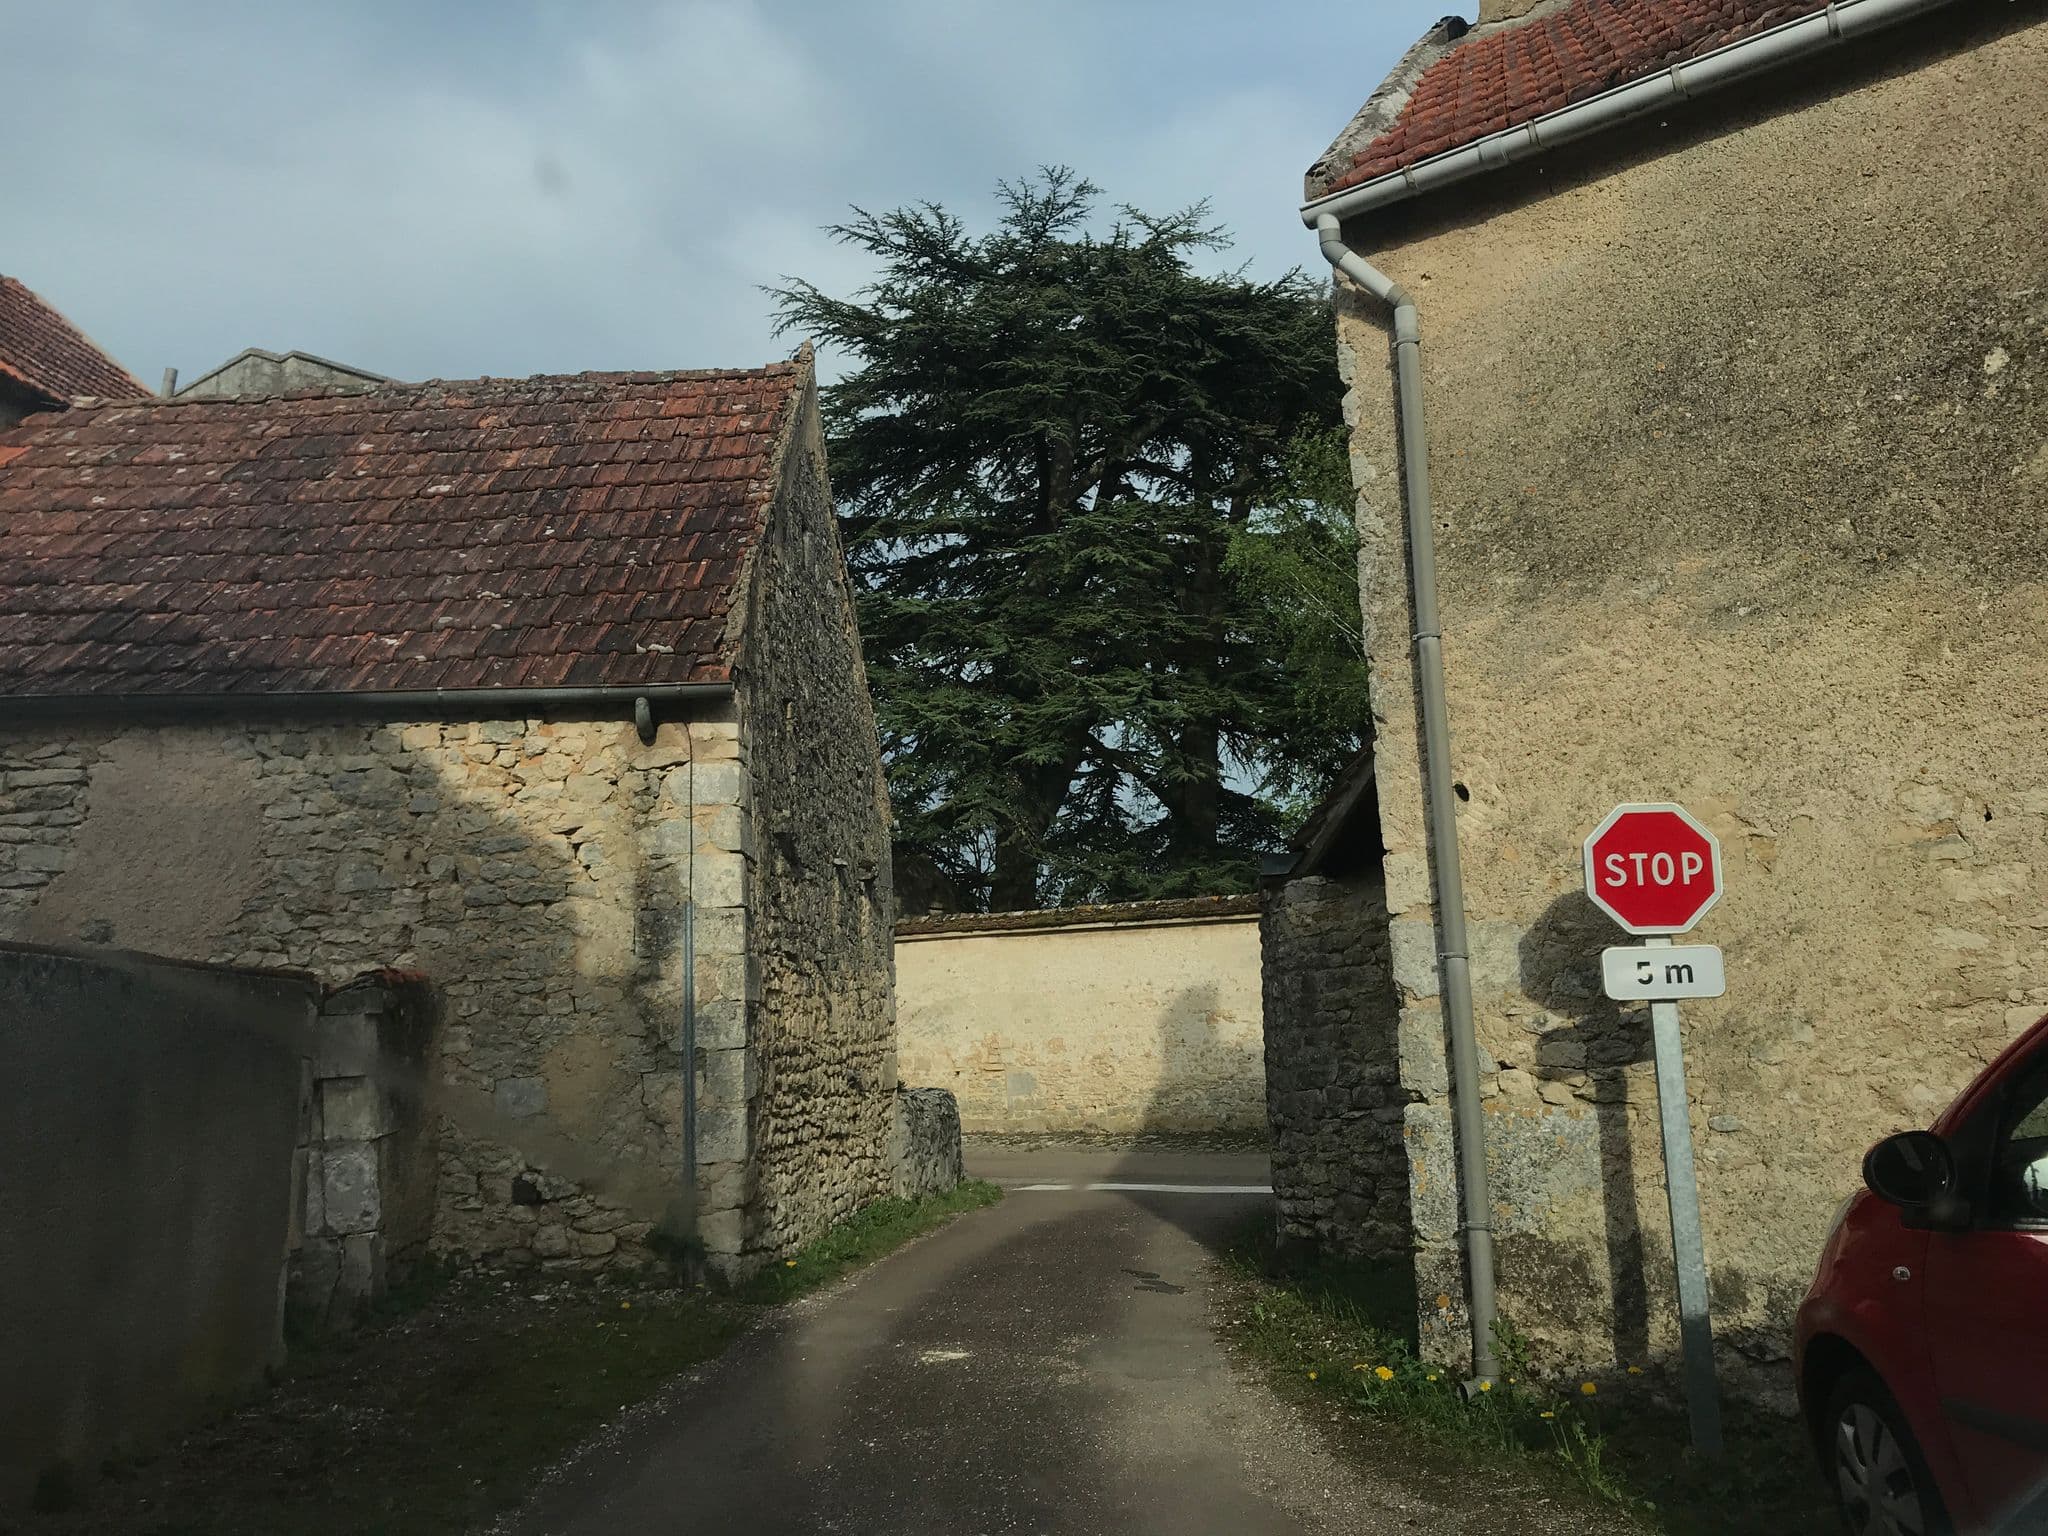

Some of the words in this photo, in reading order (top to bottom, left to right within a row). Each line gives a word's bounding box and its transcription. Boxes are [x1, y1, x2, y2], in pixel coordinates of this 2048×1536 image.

[1605, 852, 1704, 887] STOP
[1637, 961, 1654, 985] 5
[1665, 963, 1694, 984] m
